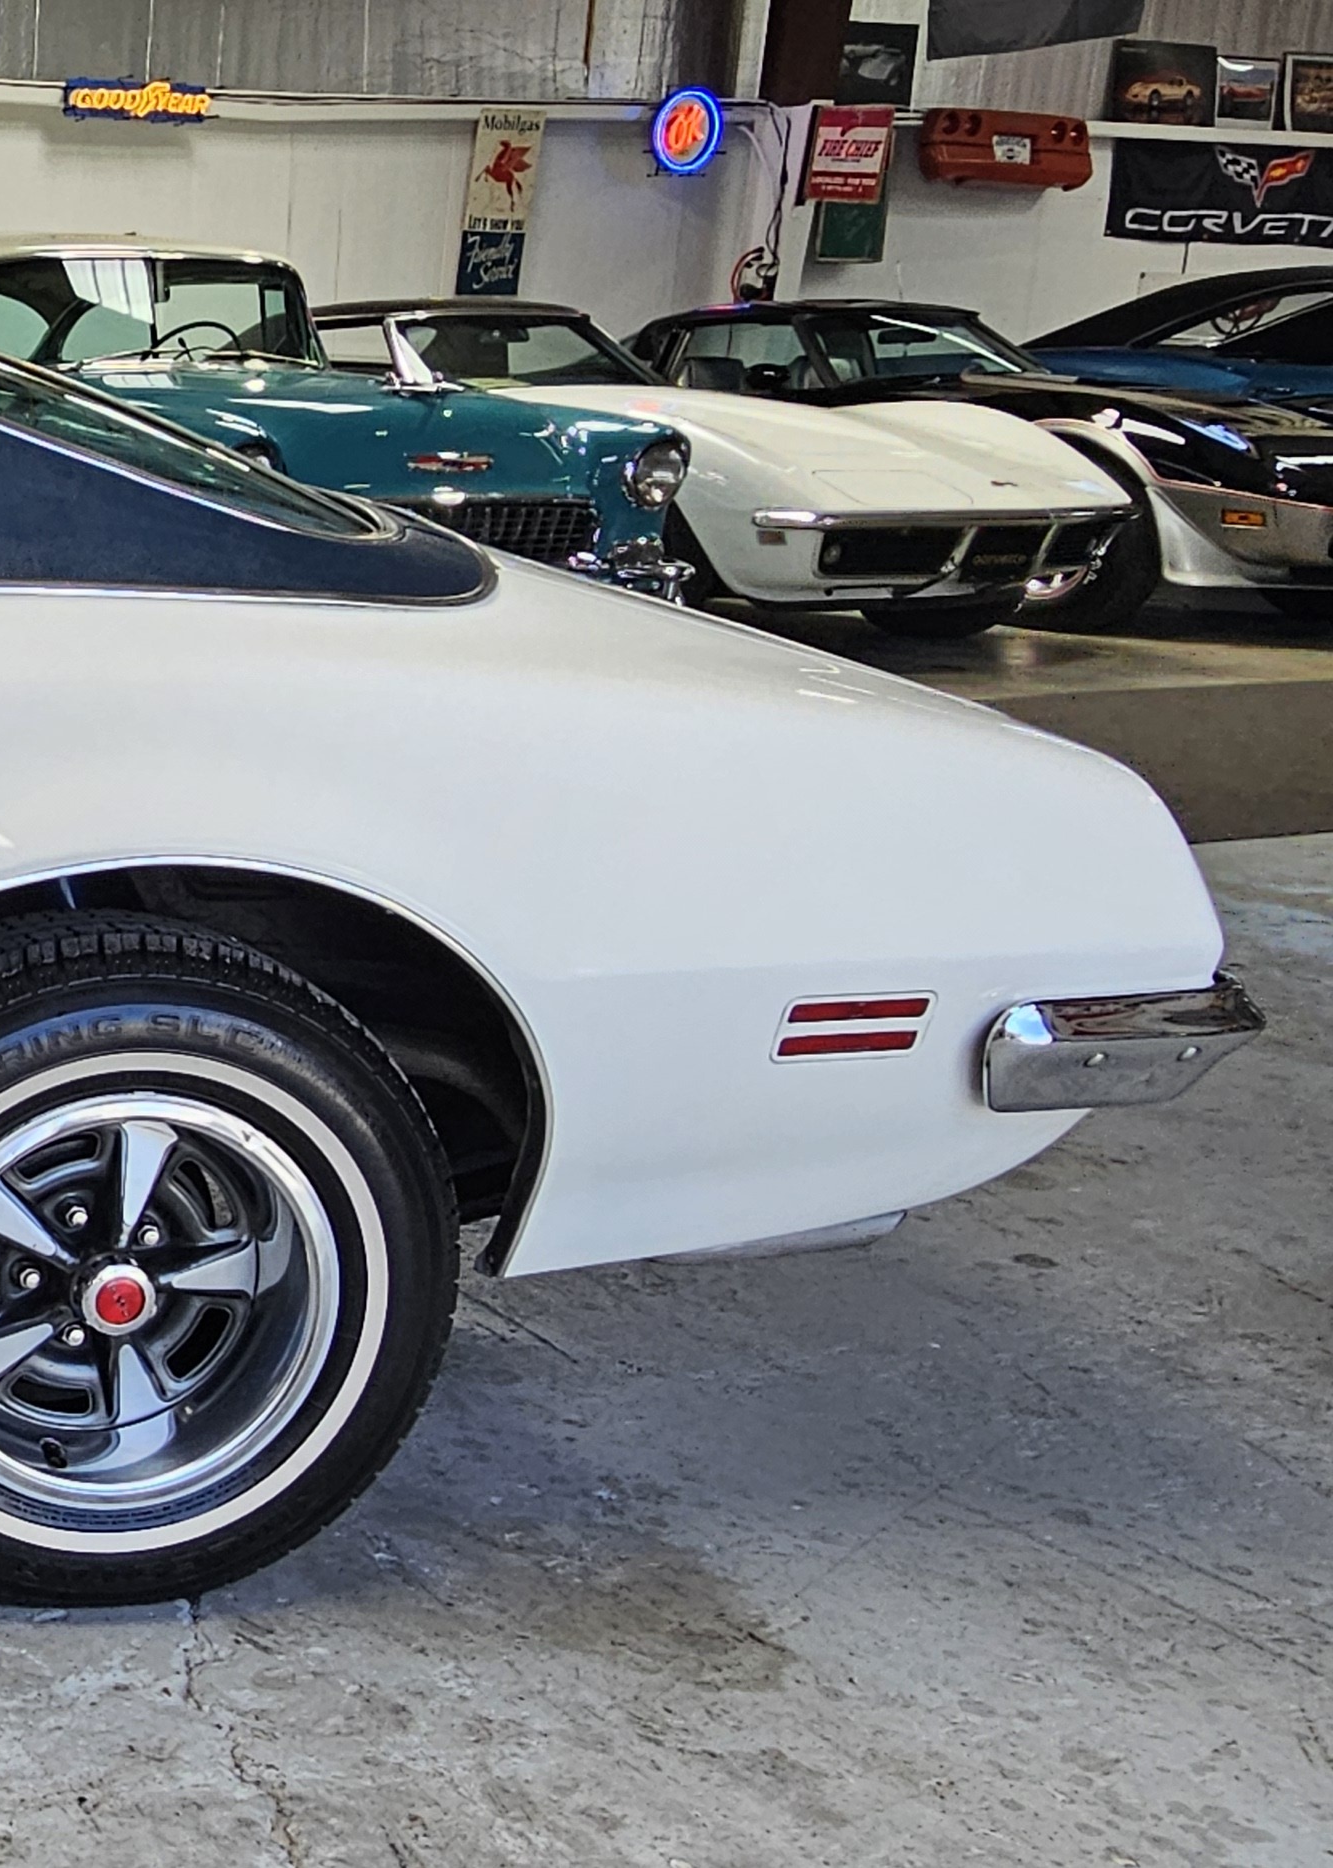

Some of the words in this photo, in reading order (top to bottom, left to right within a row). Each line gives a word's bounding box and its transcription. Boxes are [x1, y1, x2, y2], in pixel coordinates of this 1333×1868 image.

[69, 81, 214, 118] GOODYEAR
[482, 114, 541, 135] Mobilgas
[664, 103, 706, 153] OK
